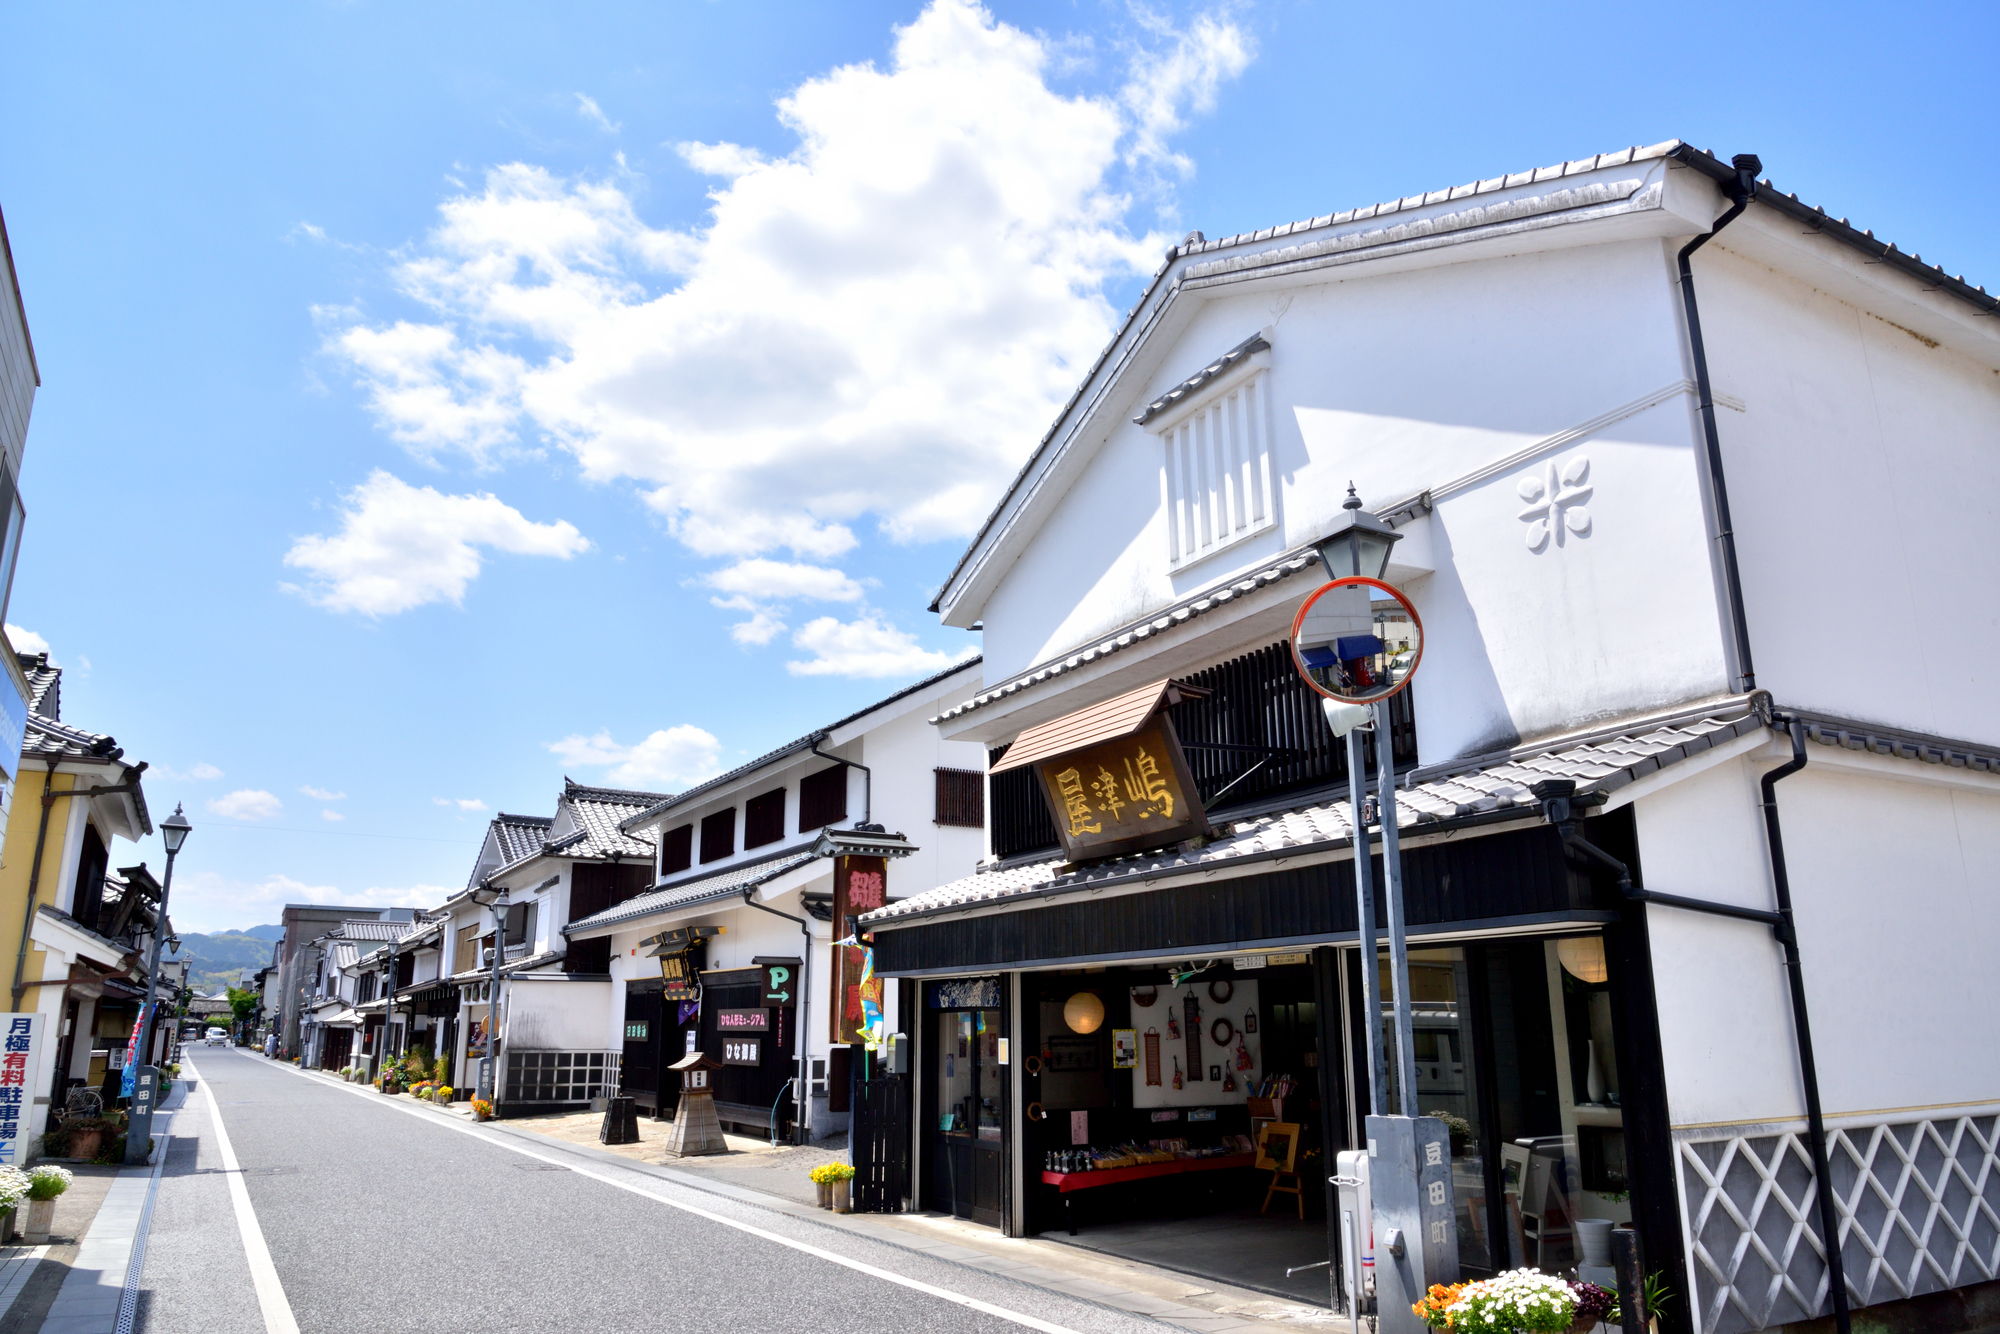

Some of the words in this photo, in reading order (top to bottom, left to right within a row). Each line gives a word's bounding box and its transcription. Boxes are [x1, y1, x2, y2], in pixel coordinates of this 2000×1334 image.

[769, 966, 790, 990] P
[720, 1013, 765, 1026] ひな人形ミュージアム
[0, 1018, 32, 1139] 月極有料駐車場
[136, 1075, 152, 1115] 豆田町
[1425, 1141, 1448, 1244] 豆田町
